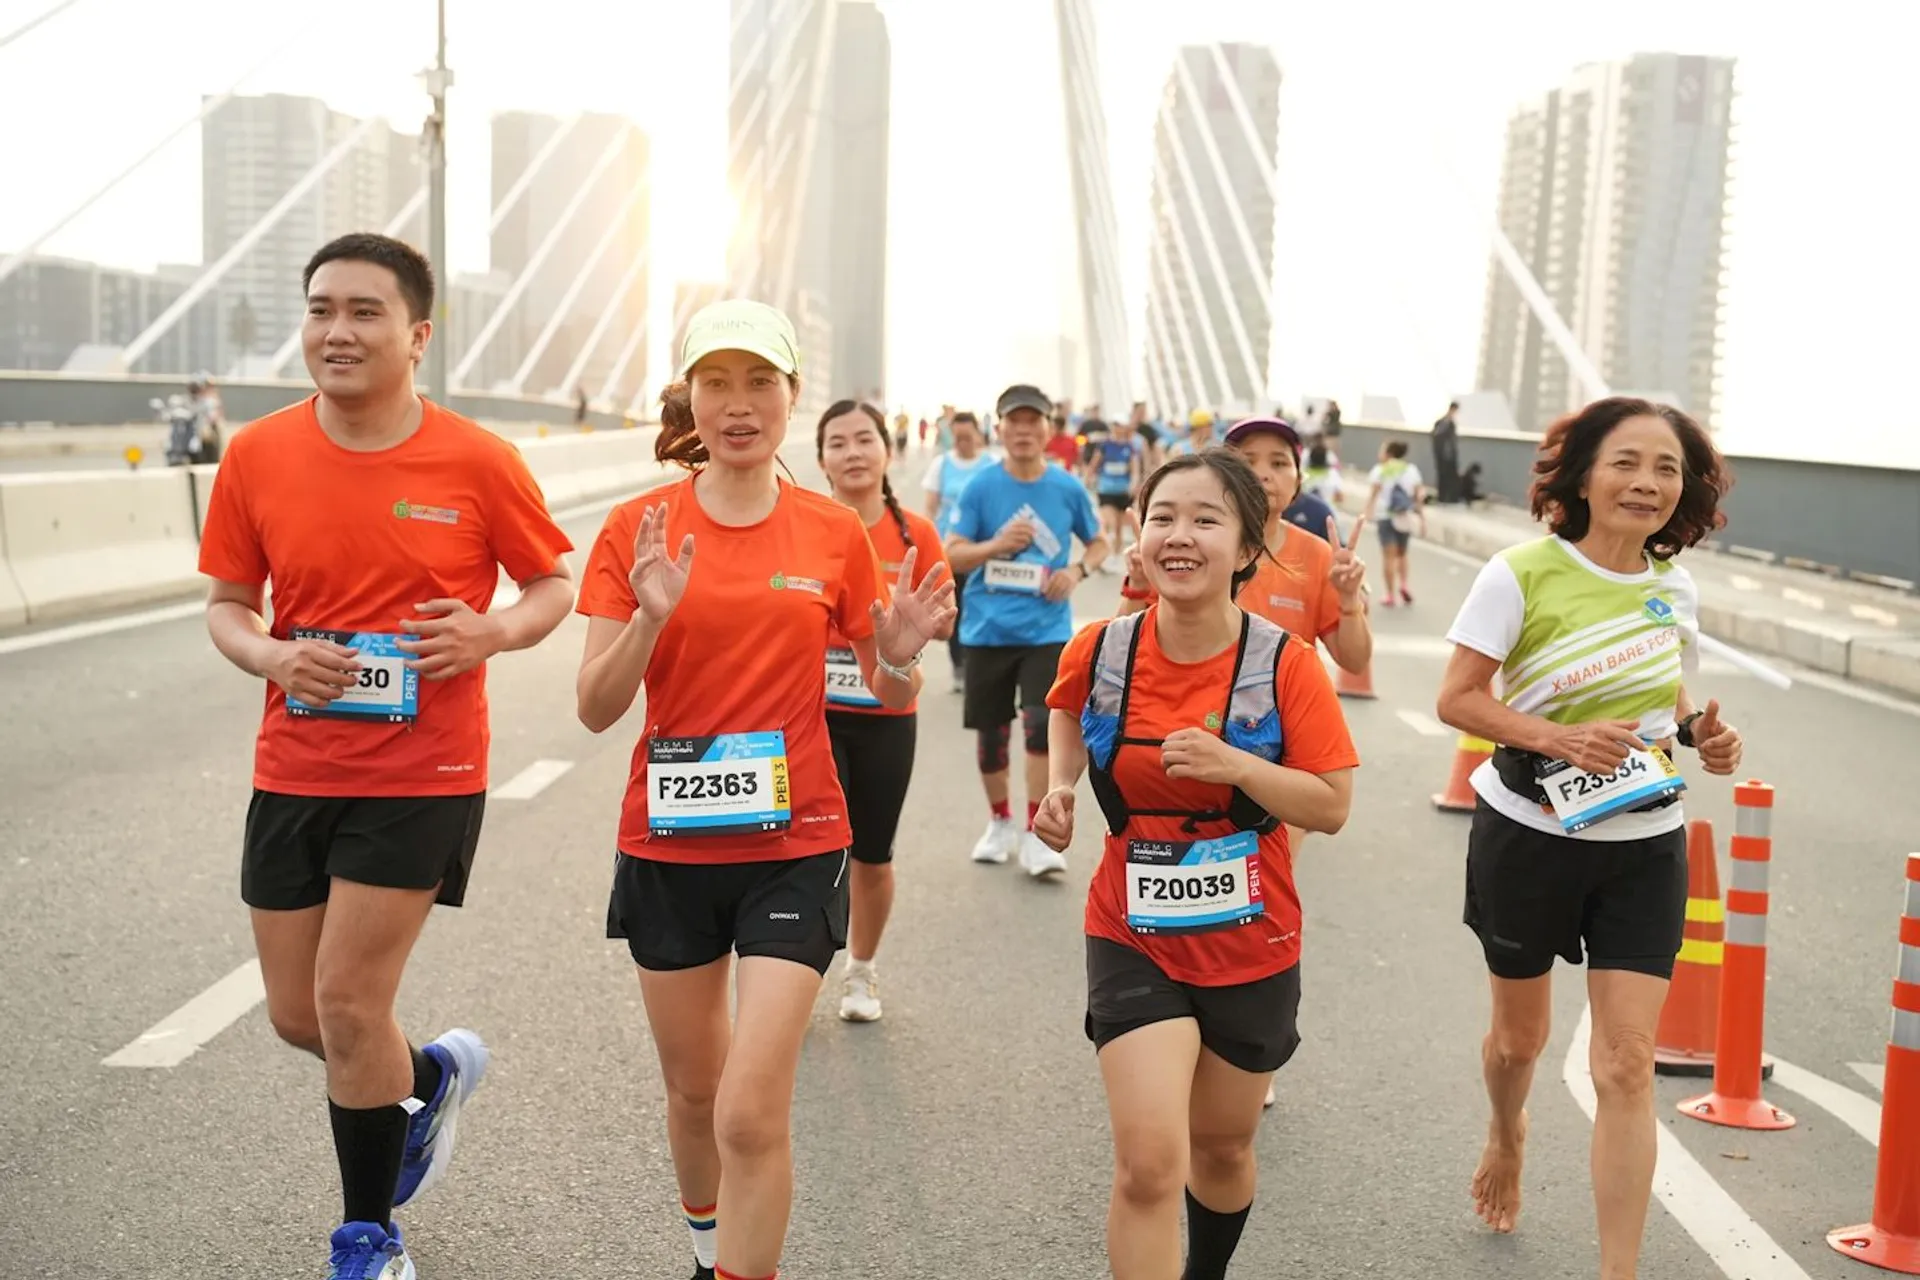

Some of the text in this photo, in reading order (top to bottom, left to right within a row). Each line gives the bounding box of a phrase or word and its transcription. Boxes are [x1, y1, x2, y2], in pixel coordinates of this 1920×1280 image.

[827, 672, 864, 688] F221
[1552, 662, 1603, 692] X-MAN
[1606, 643, 1646, 669] BARE
[405, 674, 416, 700] PEN
[658, 771, 758, 800] F22363
[774, 762, 787, 803] PEN 3
[1138, 873, 1235, 900] F20039
[1249, 861, 1261, 897] PEN 1
